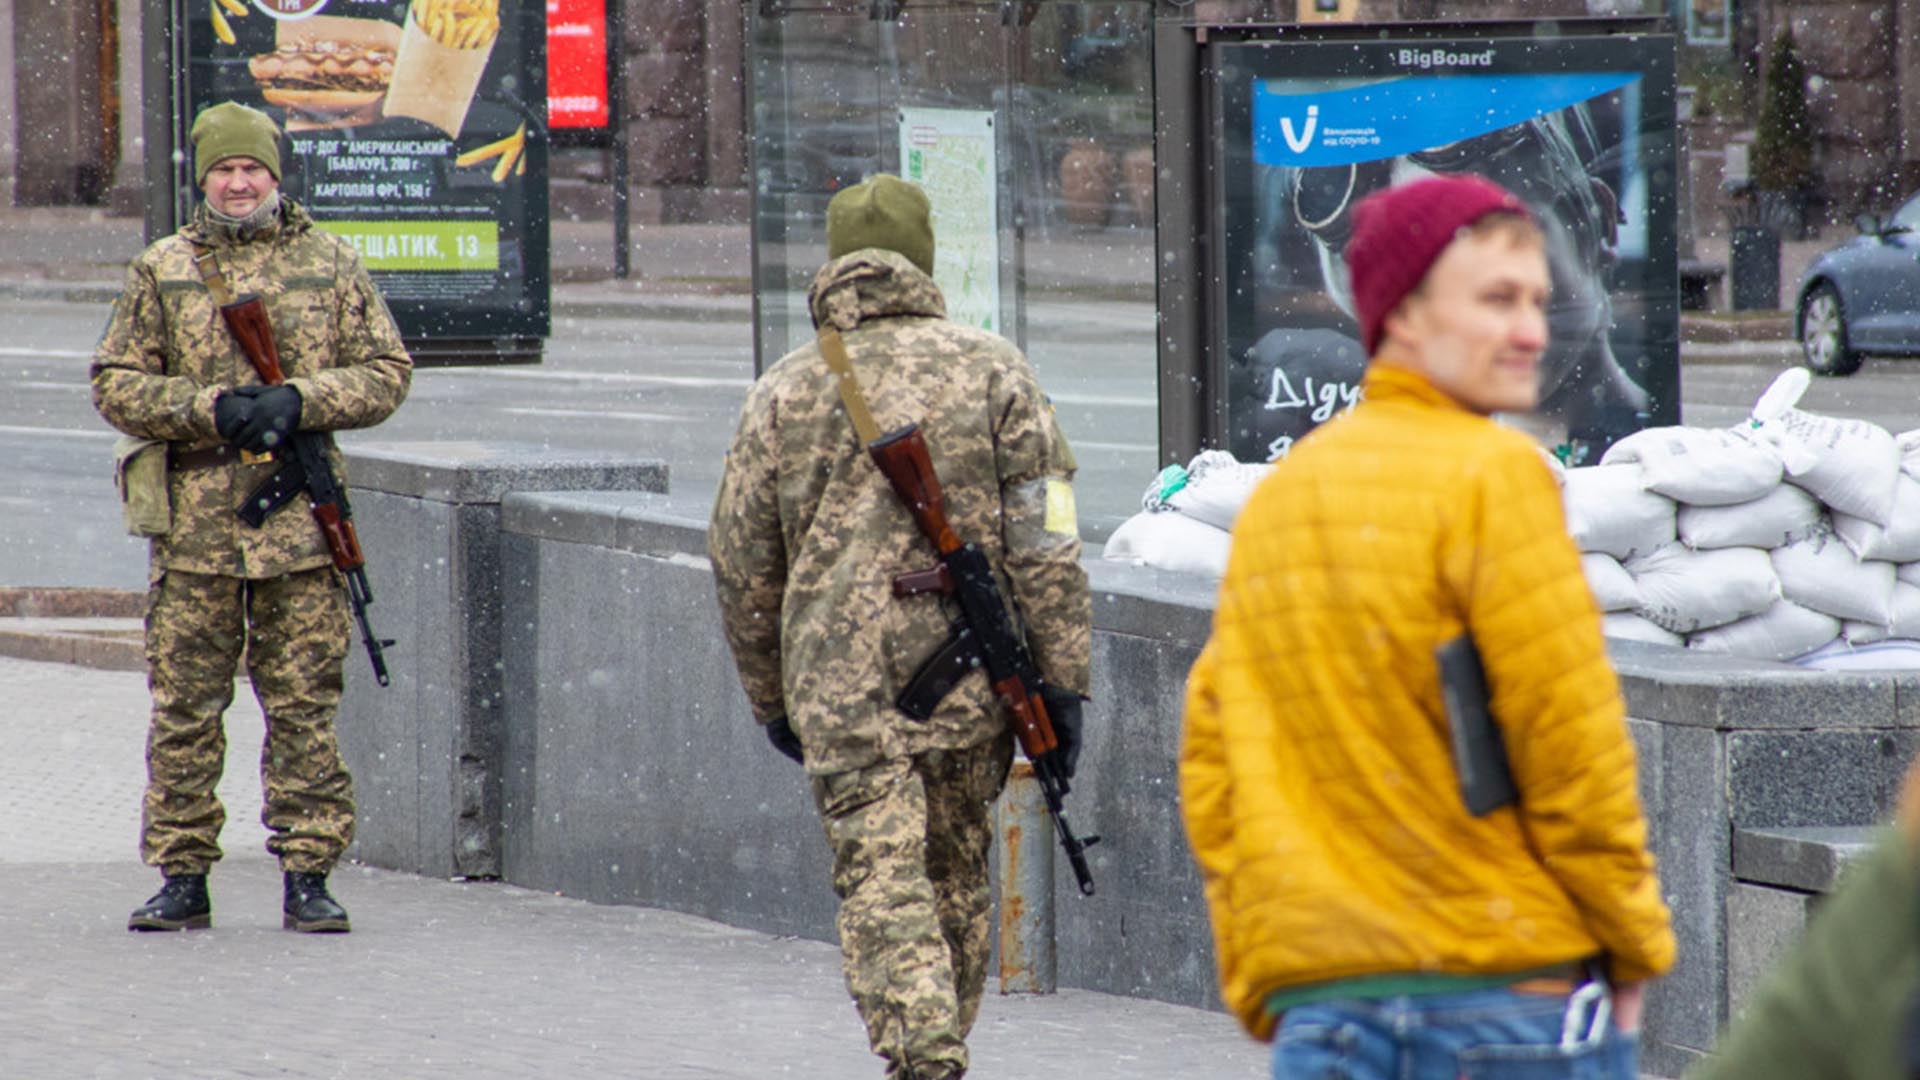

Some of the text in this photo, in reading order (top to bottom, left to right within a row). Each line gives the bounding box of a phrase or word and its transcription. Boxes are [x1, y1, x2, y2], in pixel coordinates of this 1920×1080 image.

[1398, 49, 1492, 69] BigBoard
[292, 140, 338, 156] ХОТ-ДОГ
[391, 157, 410, 171] 200
[314, 183, 375, 197] КАРТОПЛЯ
[455, 235, 480, 258] 13
